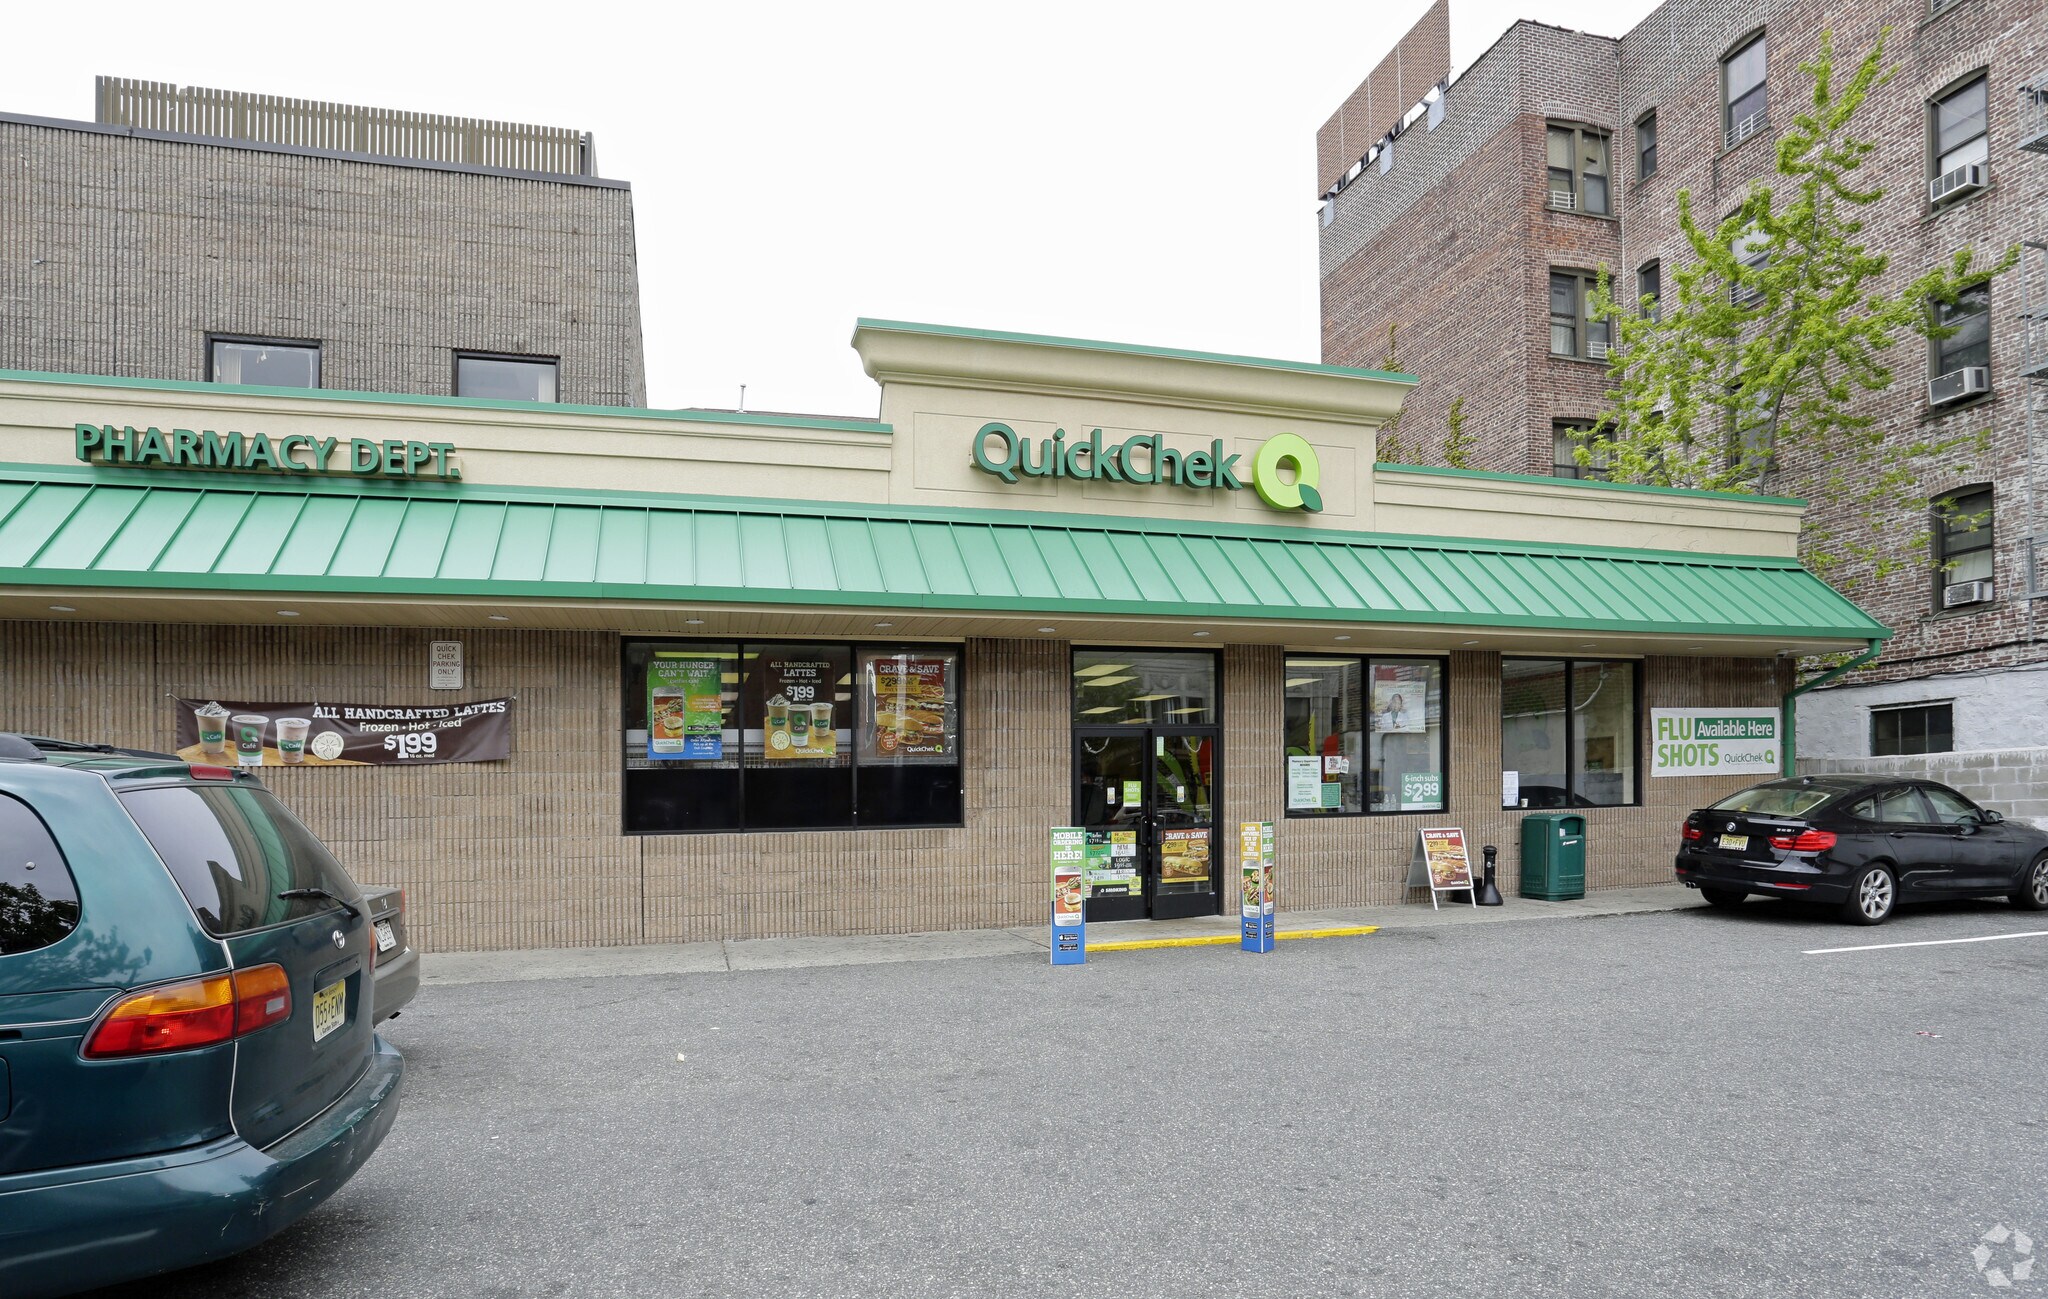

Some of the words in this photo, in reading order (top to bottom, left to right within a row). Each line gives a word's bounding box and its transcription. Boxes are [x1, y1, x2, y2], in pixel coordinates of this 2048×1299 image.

[75, 423, 338, 473] PHARMACY
[350, 437, 463, 480] DEPT.
[972, 422, 1244, 491] QuickChek
[880, 664, 908, 673] CRAVE
[910, 665, 916, 673] &
[918, 665, 939, 673] SAVE
[786, 686, 814, 701] $199
[313, 706, 340, 718] ALL
[345, 708, 449, 719] HANDCRAFTED
[454, 702, 506, 716] LATTES
[360, 722, 399, 732] Frozen
[409, 722, 430, 731] Hot
[438, 718, 462, 728] Iced
[1658, 718, 1692, 740] FLU
[1697, 720, 1745, 736] Available
[1747, 720, 1773, 736] Here
[384, 732, 437, 759] $199
[1658, 743, 1719, 767] SHOTS
[1724, 753, 1763, 764] QuickChek
[1405, 782, 1439, 801] $299
[1053, 850, 1083, 860] HERE!
